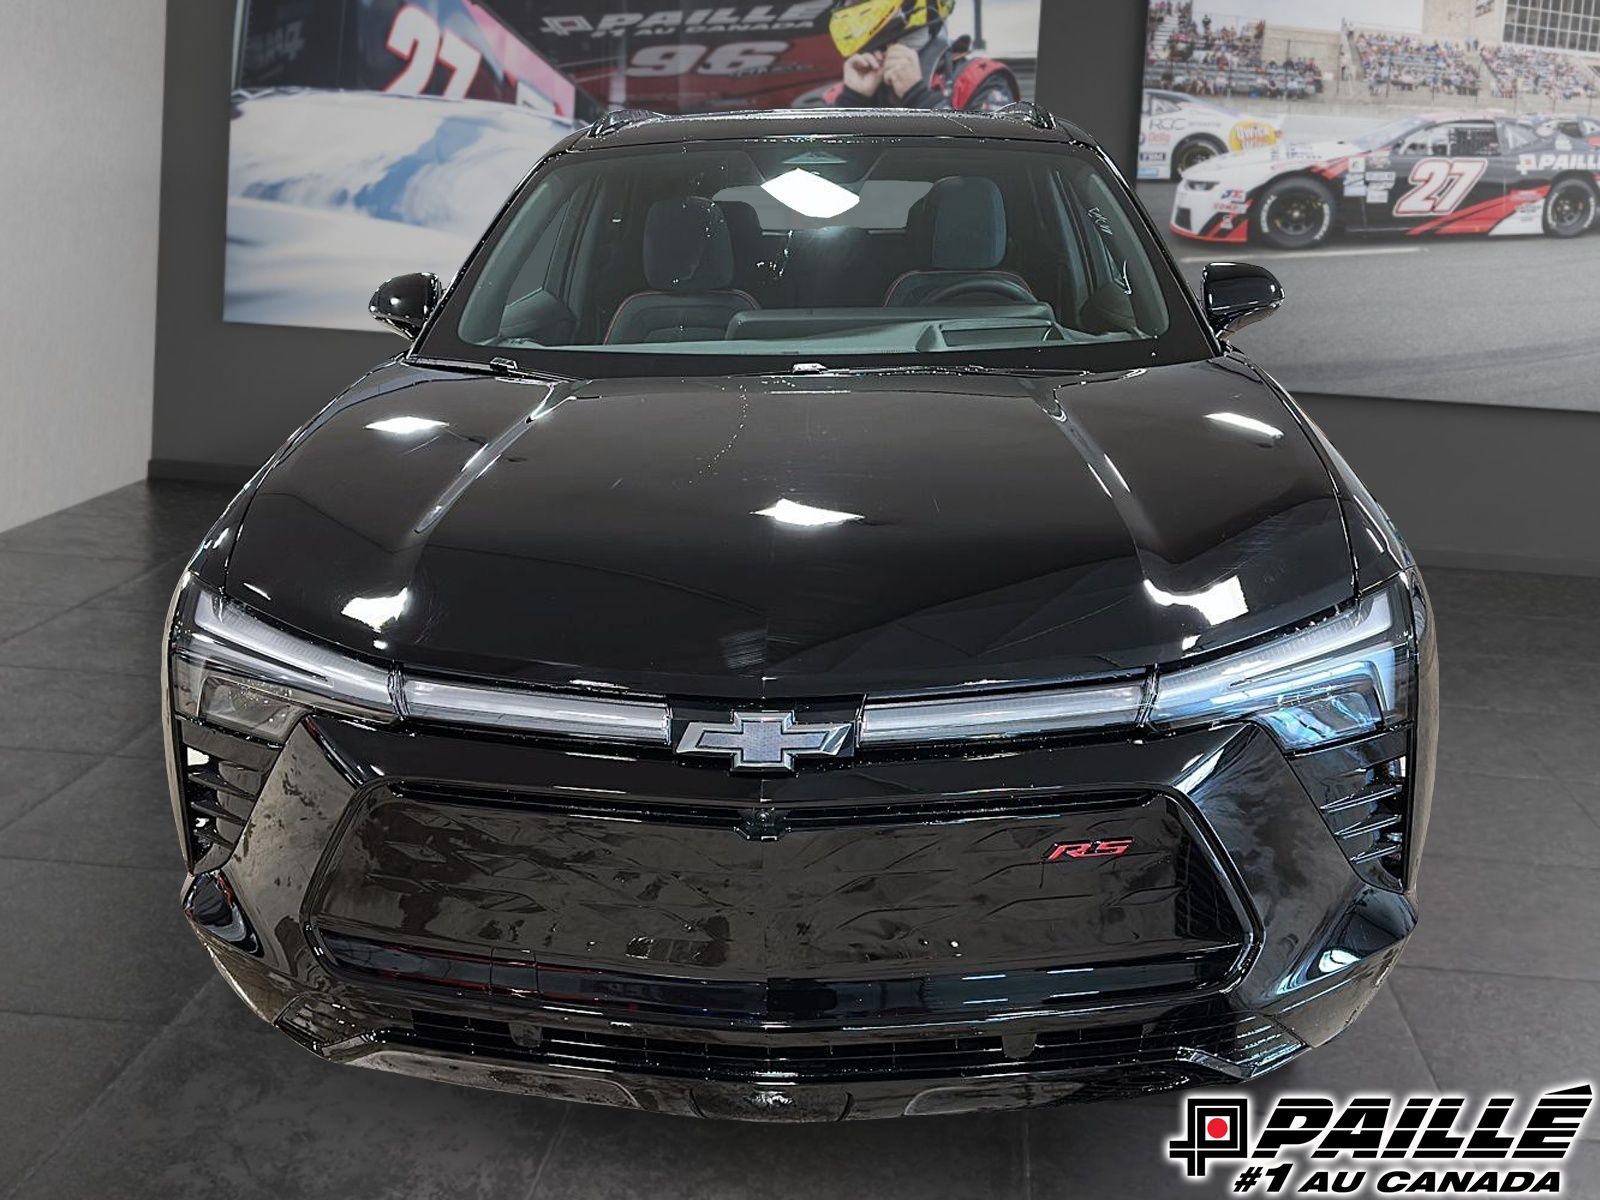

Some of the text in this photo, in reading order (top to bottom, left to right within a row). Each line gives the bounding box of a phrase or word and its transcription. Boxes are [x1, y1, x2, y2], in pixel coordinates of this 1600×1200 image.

[685, 20, 814, 34] CANADA
[384, 4, 483, 100] 27
[625, 41, 789, 77] 96
[1393, 157, 1488, 217] 27
[1044, 837, 1134, 863] RS
